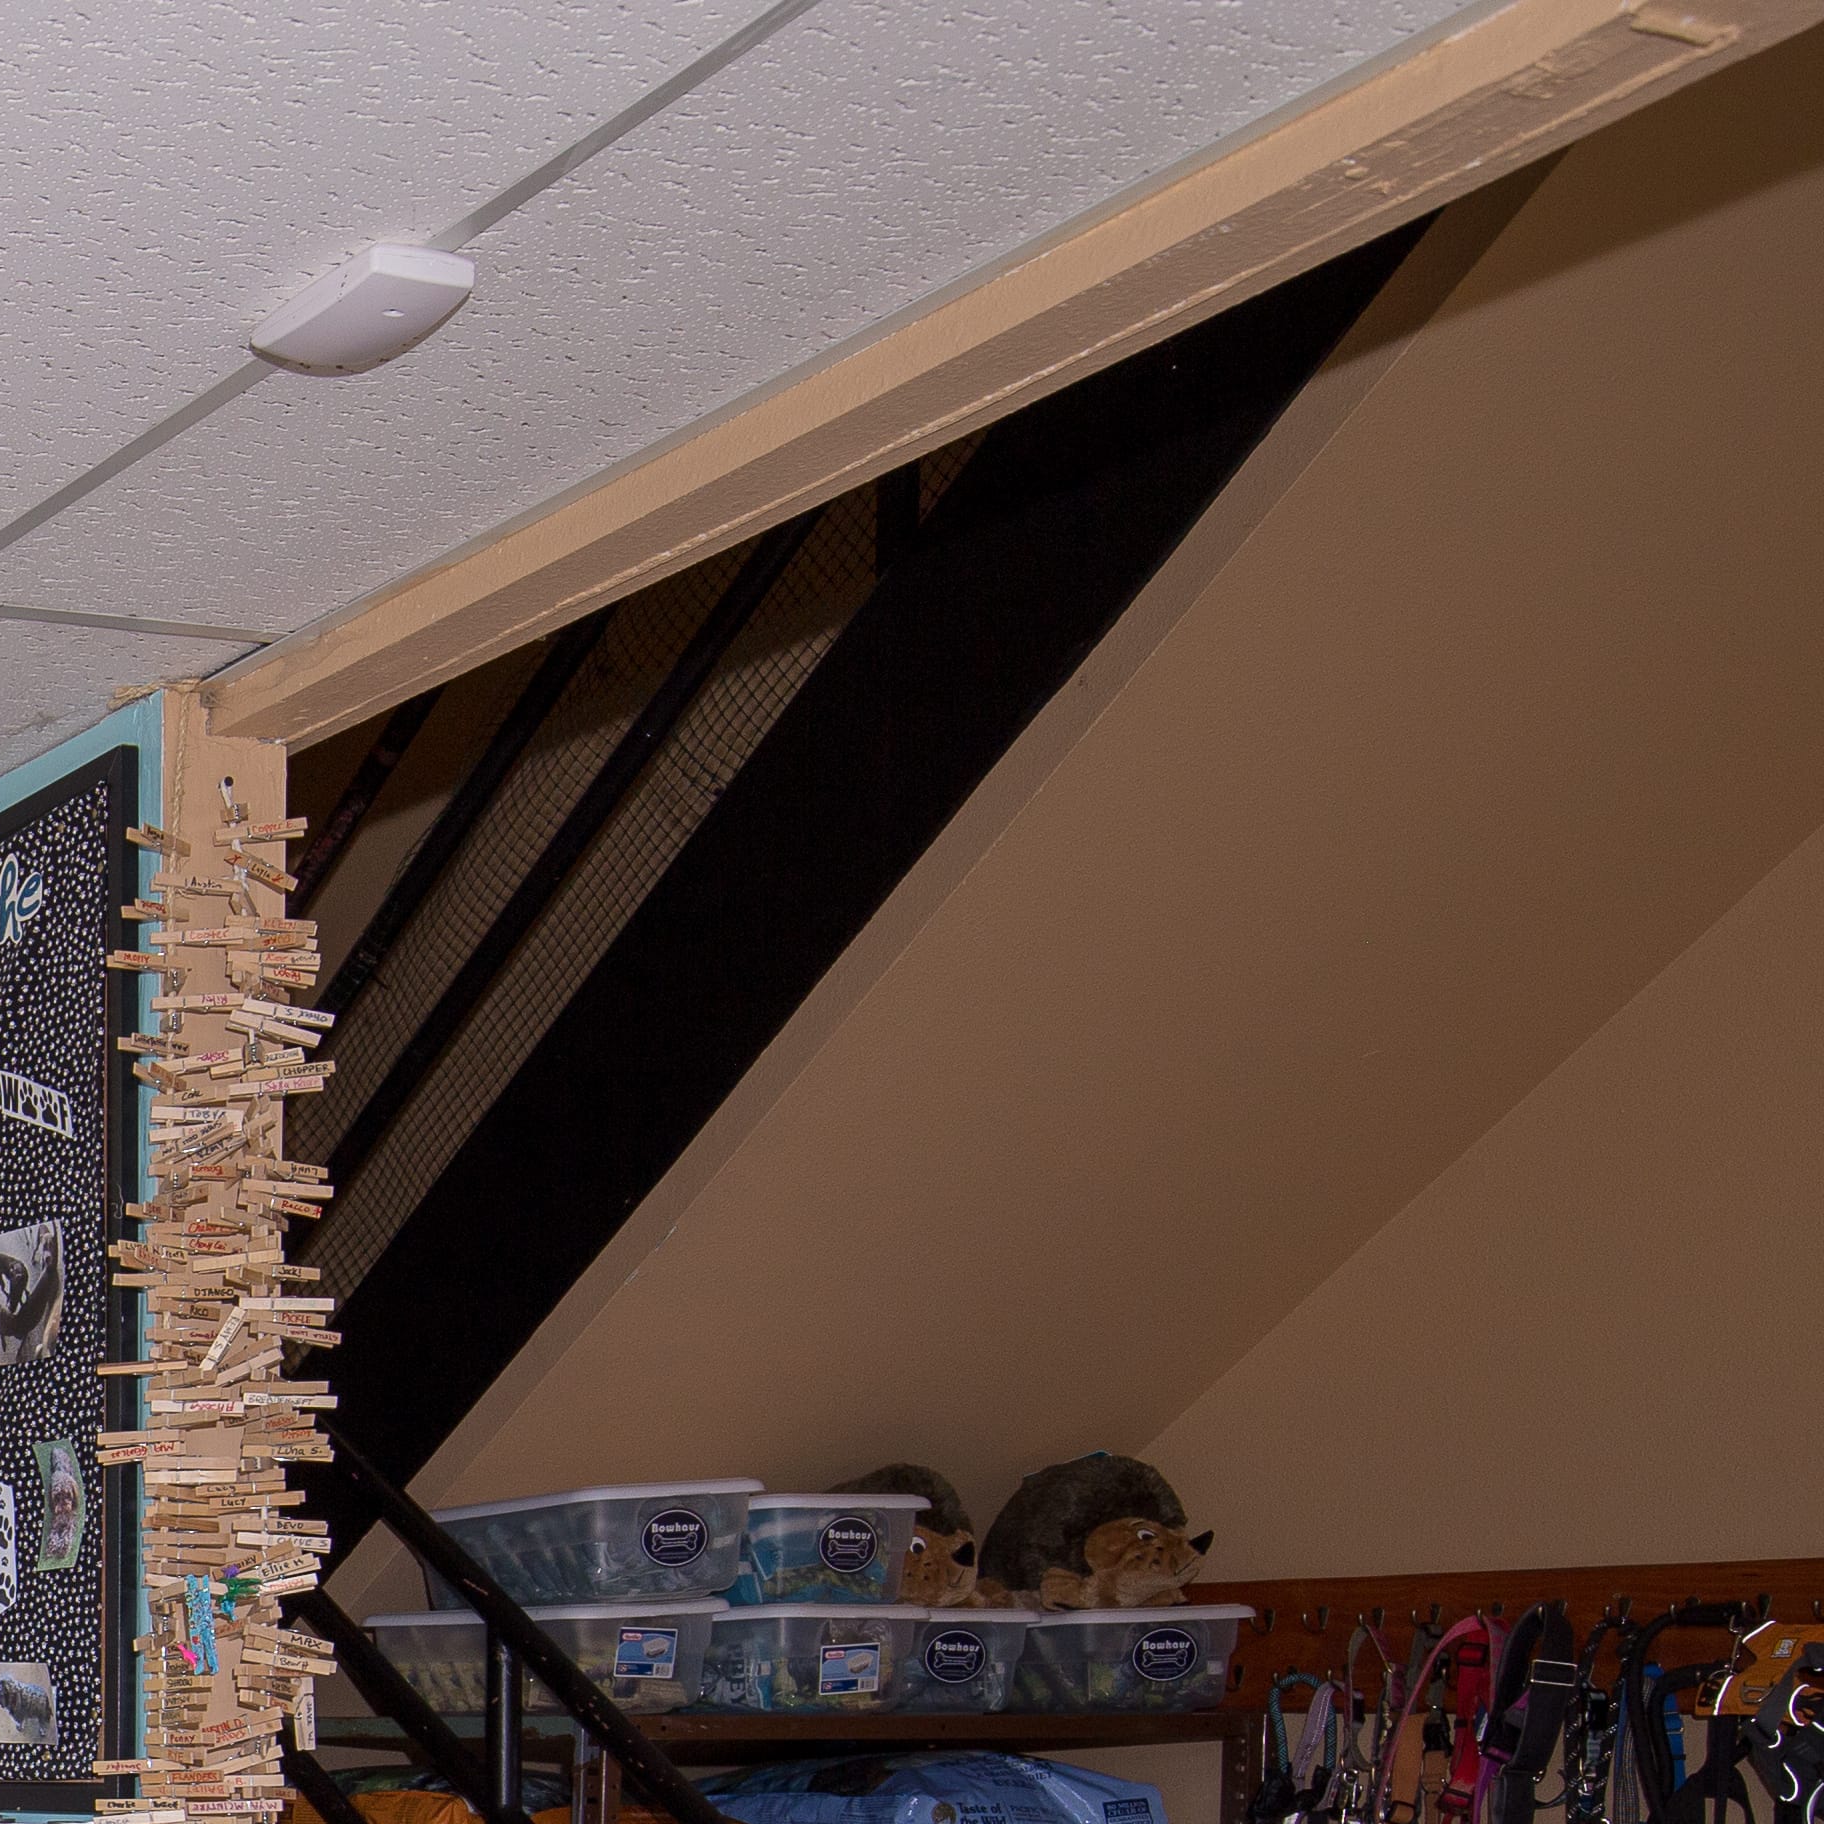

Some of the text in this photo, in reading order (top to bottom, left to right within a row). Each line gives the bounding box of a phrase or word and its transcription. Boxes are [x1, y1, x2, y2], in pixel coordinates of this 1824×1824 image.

[193, 1287, 235, 1298] DJANGO
[651, 1522, 700, 1533] Bowhaus
[828, 1529, 872, 1540] Bowhaus
[935, 1641, 980, 1652] Bowhaus
[1142, 1640, 1190, 1650] Bowhaus
